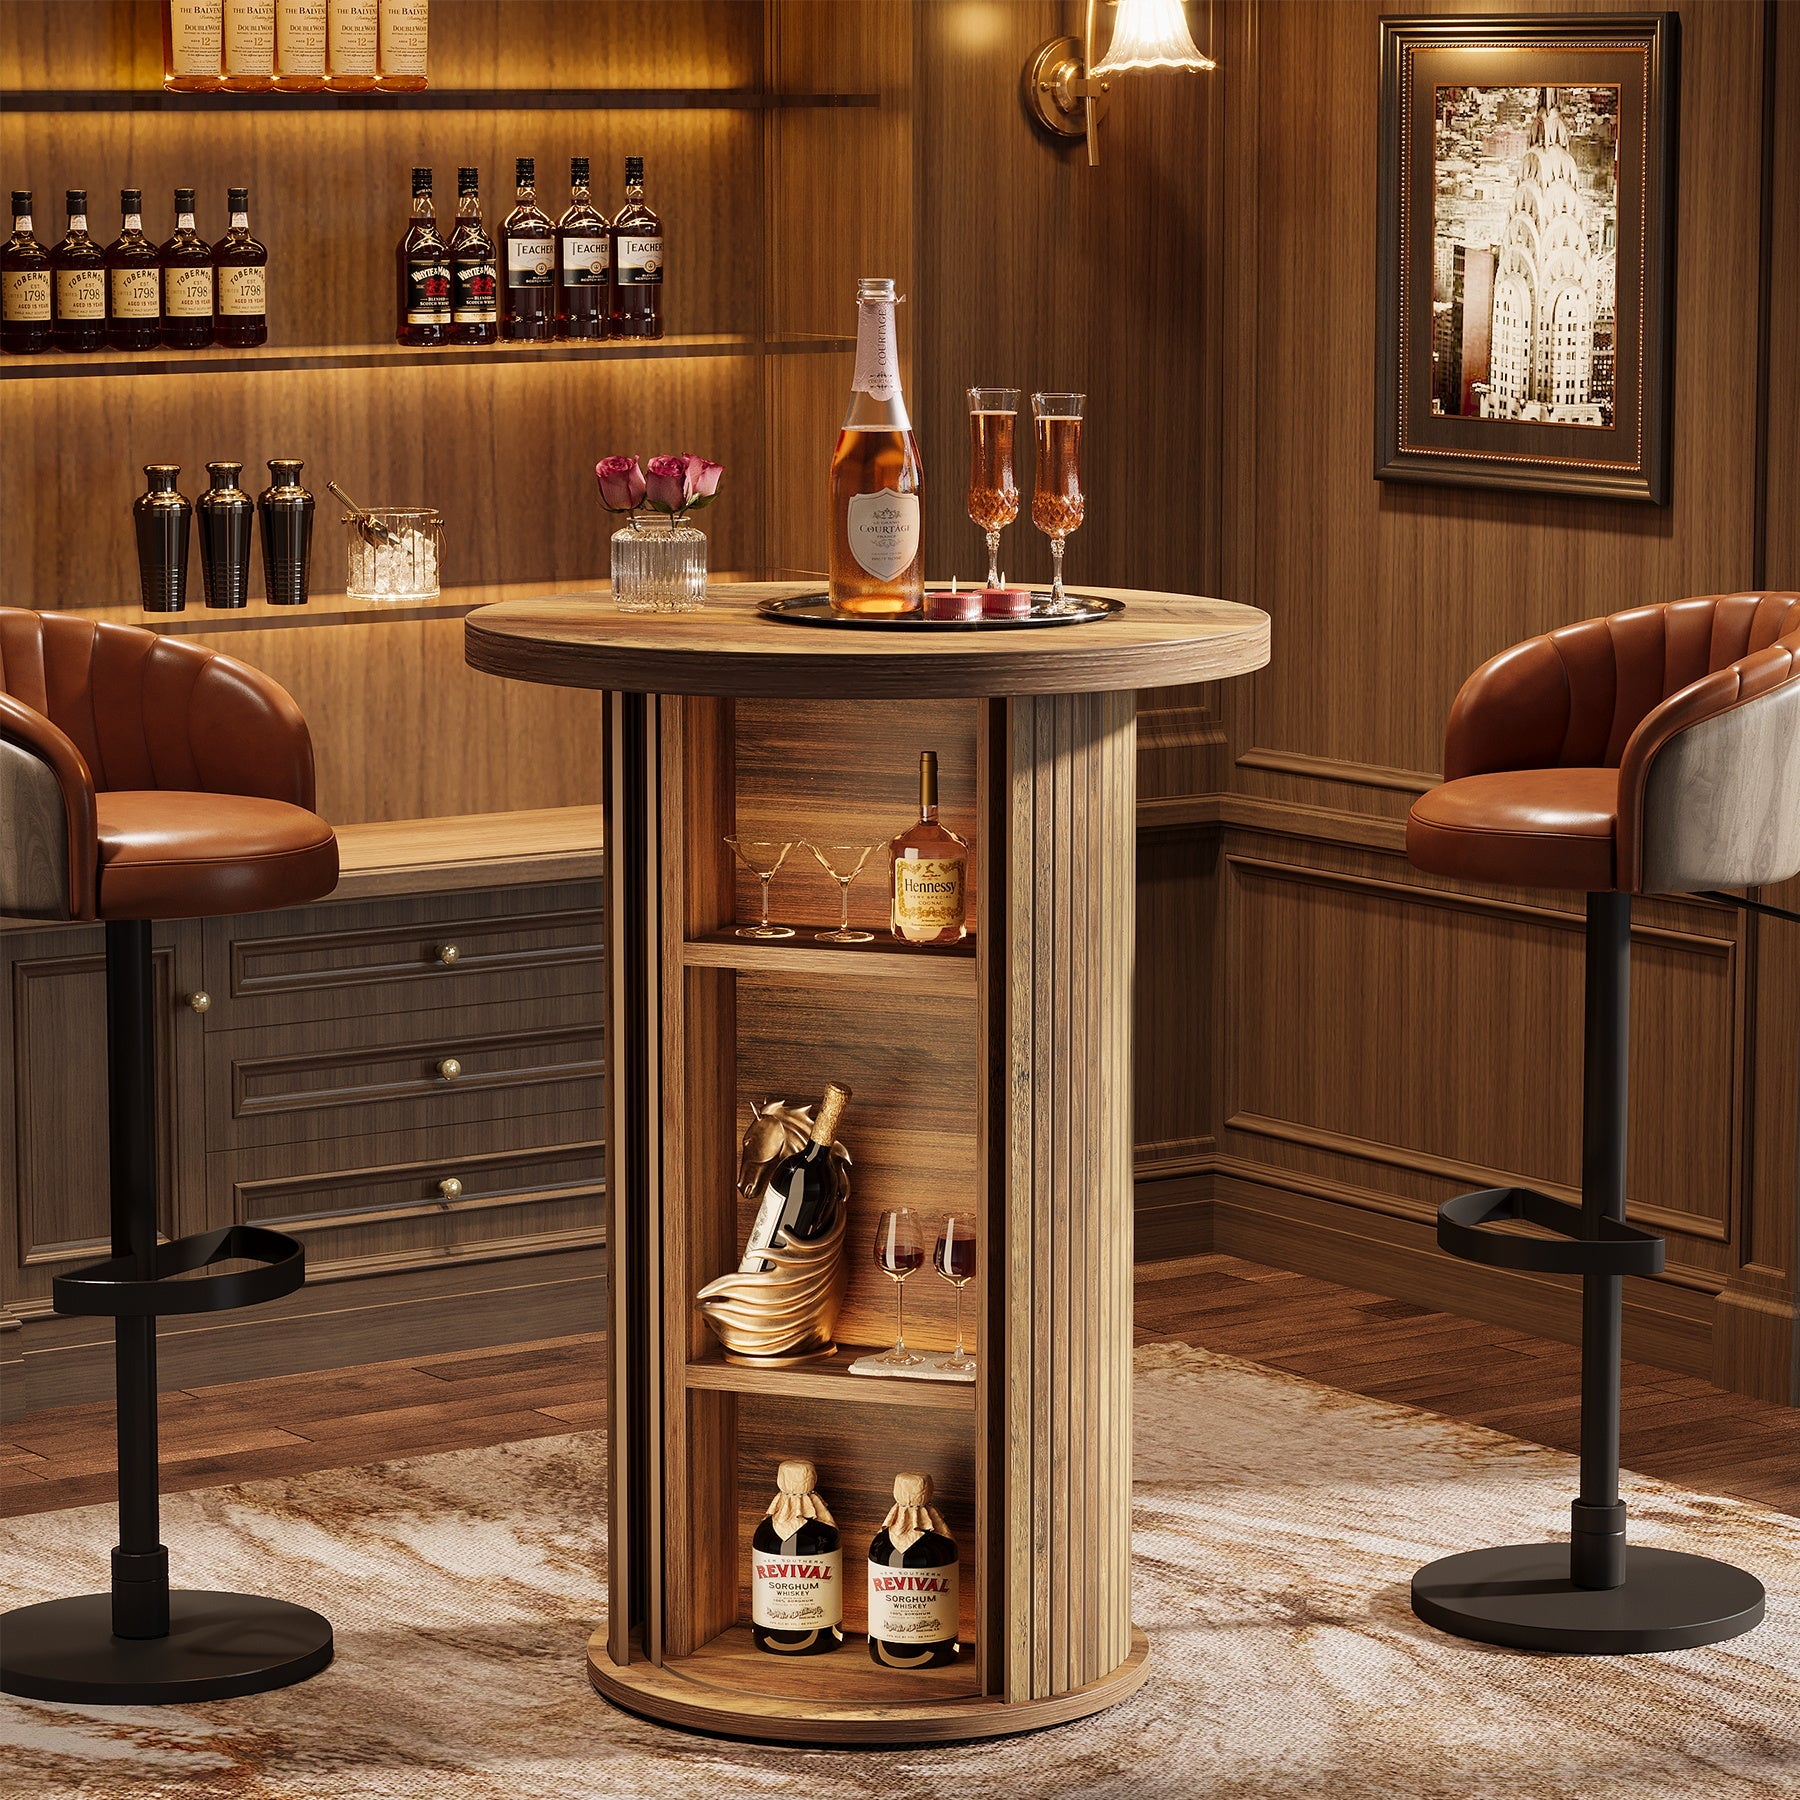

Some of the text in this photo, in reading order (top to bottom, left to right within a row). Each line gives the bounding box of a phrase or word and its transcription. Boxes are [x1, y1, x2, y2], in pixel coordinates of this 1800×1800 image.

[201, 37, 210, 46] 12
[254, 37, 263, 46] 12
[306, 37, 315, 46] 12
[357, 37, 366, 46] 12
[408, 37, 418, 46] 12
[411, 268, 434, 282] WHYTE
[458, 267, 481, 281] WHYTE
[24, 290, 46, 302] 1798
[78, 288, 100, 300] 1798
[133, 287, 154, 299] 1798
[187, 286, 208, 298] 1798
[241, 284, 261, 296] 1798
[905, 878, 956, 894] Hennessy
[756, 1564, 832, 1580] REVIVAL
[768, 1582, 819, 1590] SORGHUM
[872, 1576, 950, 1593] REVIVAL
[886, 1594, 936, 1602] SORGHUM
